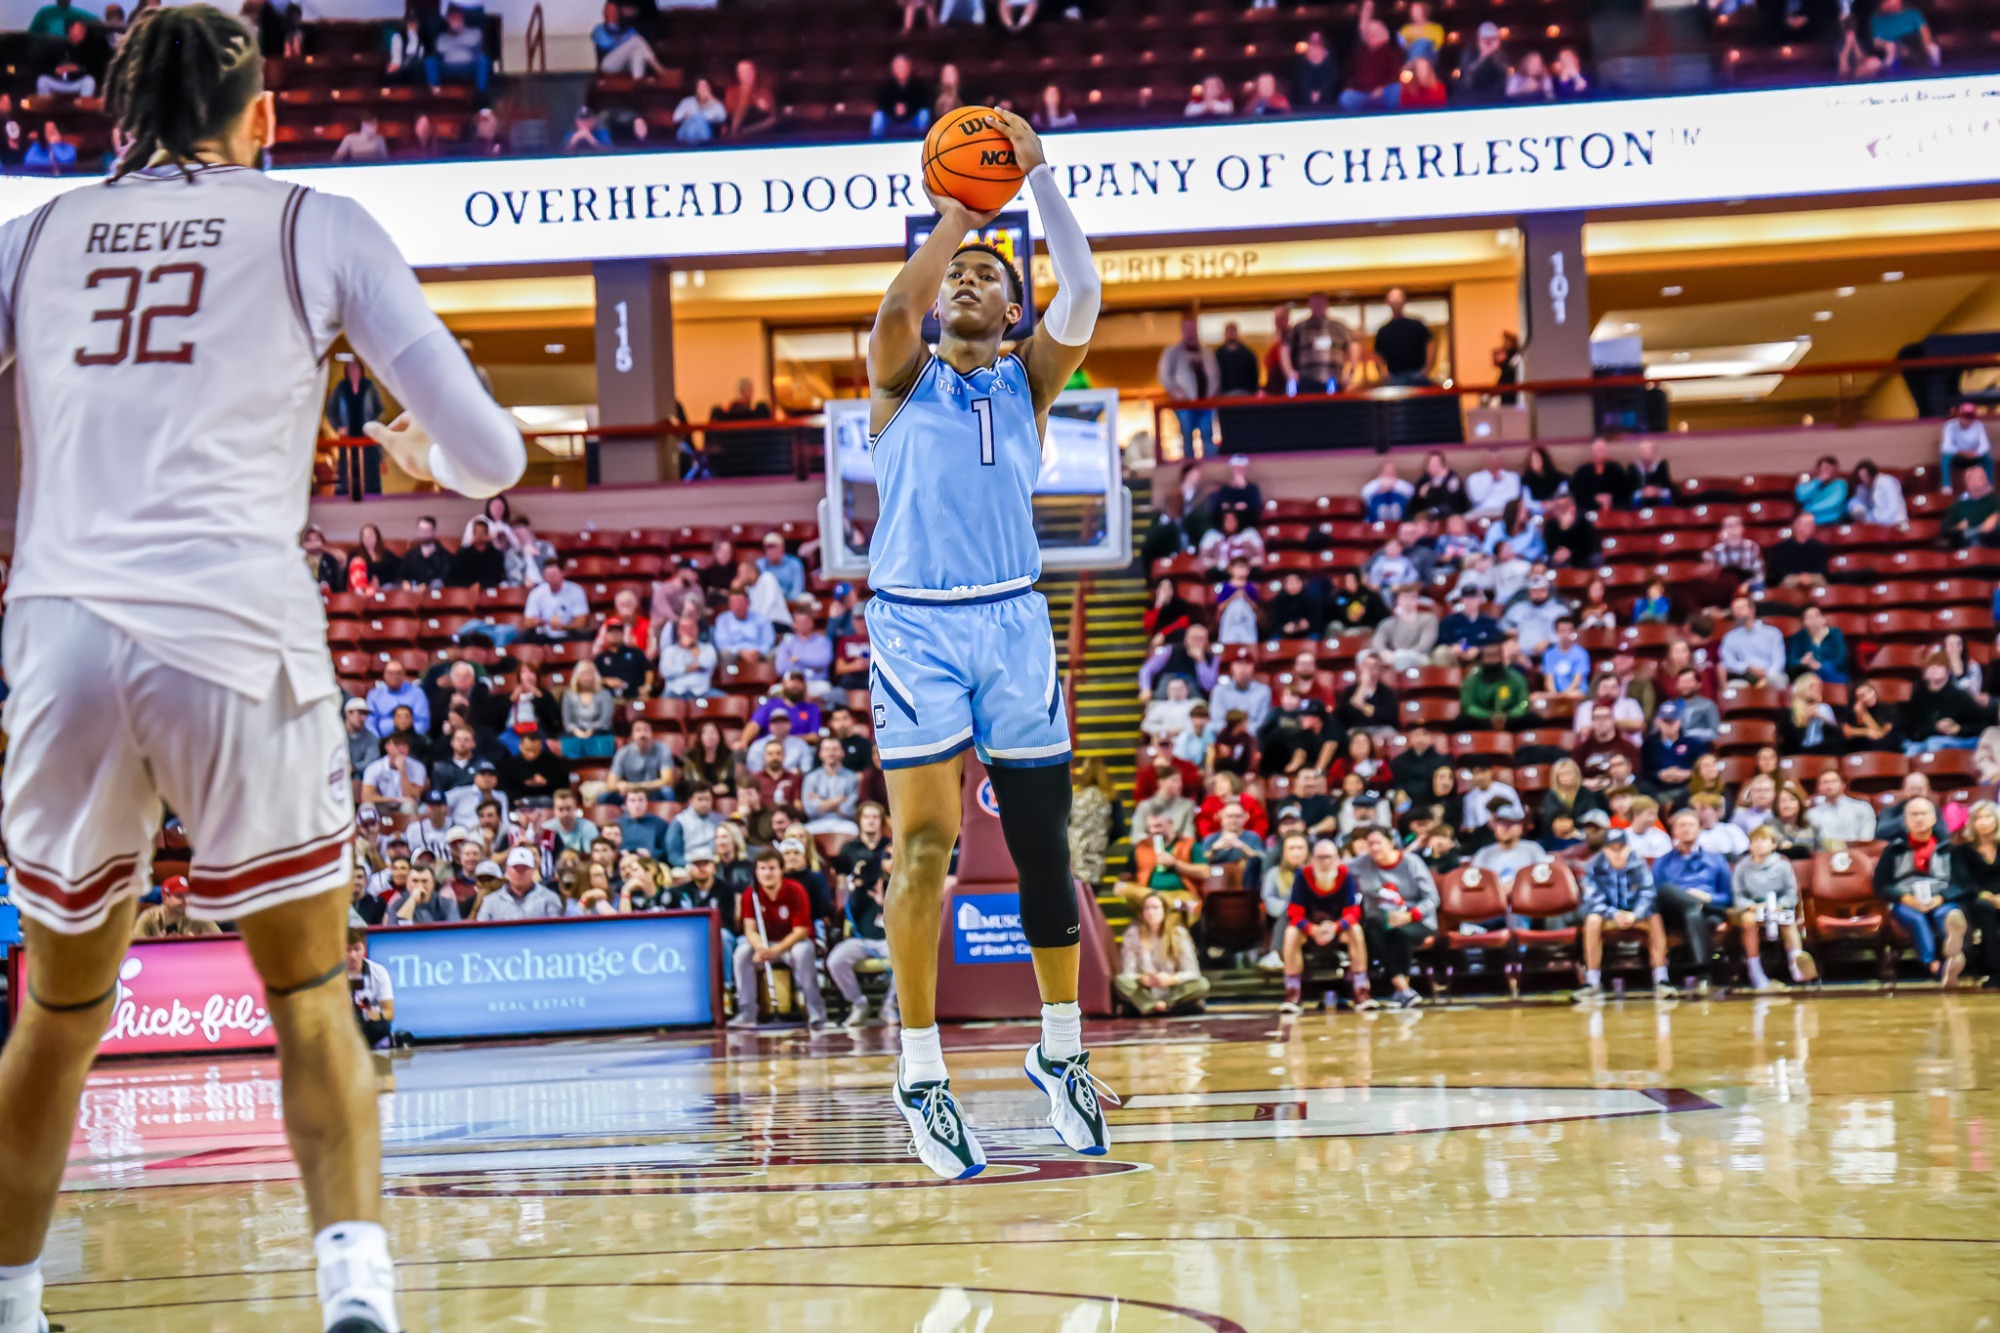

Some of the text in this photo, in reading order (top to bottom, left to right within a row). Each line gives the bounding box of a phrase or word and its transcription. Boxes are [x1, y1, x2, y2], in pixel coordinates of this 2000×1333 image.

[465, 180, 742, 227] OVERHEAD
[763, 173, 915, 213] DOOR
[1050, 158, 1196, 198] PANY
[1216, 153, 1286, 191] OF
[1303, 129, 1656, 186] CHARLESTON
[85, 218, 226, 253] REEVES
[1098, 250, 1259, 277] PIRIT SHOP
[73, 261, 208, 366] 32
[1549, 251, 1569, 324] 101
[971, 397, 996, 466] 1
[389, 942, 687, 988] The Exchange Co.
[488, 997, 587, 1012] REAL ESTATE
